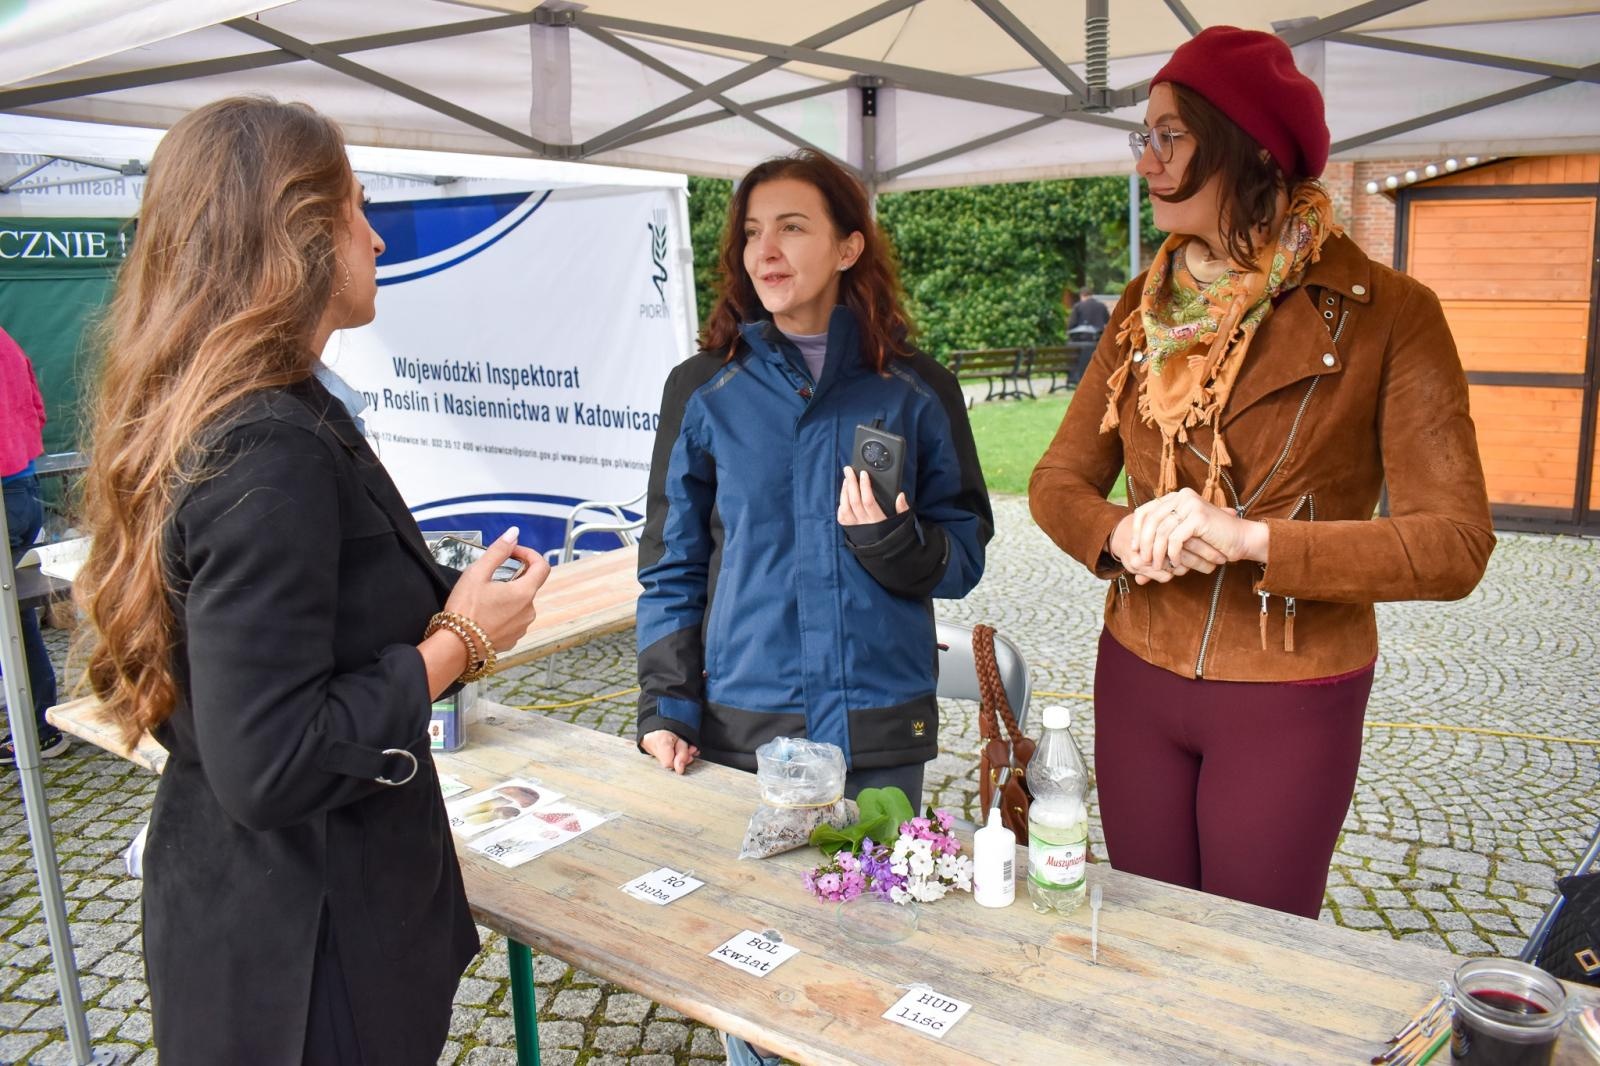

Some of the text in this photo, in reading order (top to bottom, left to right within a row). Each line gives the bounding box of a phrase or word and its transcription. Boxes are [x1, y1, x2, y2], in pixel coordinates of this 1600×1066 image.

[392, 356, 580, 390] Wojewódzki Inspektorat
[383, 387, 430, 413] Roślin
[434, 391, 440, 413] i
[443, 392, 551, 423] Nasiennictwa
[556, 405, 569, 424] w
[635, 881, 670, 900] huba
[662, 876, 686, 888] RO
[746, 937, 779, 955] BOL
[718, 945, 771, 971] kwiat
[916, 993, 959, 1014] HUD
